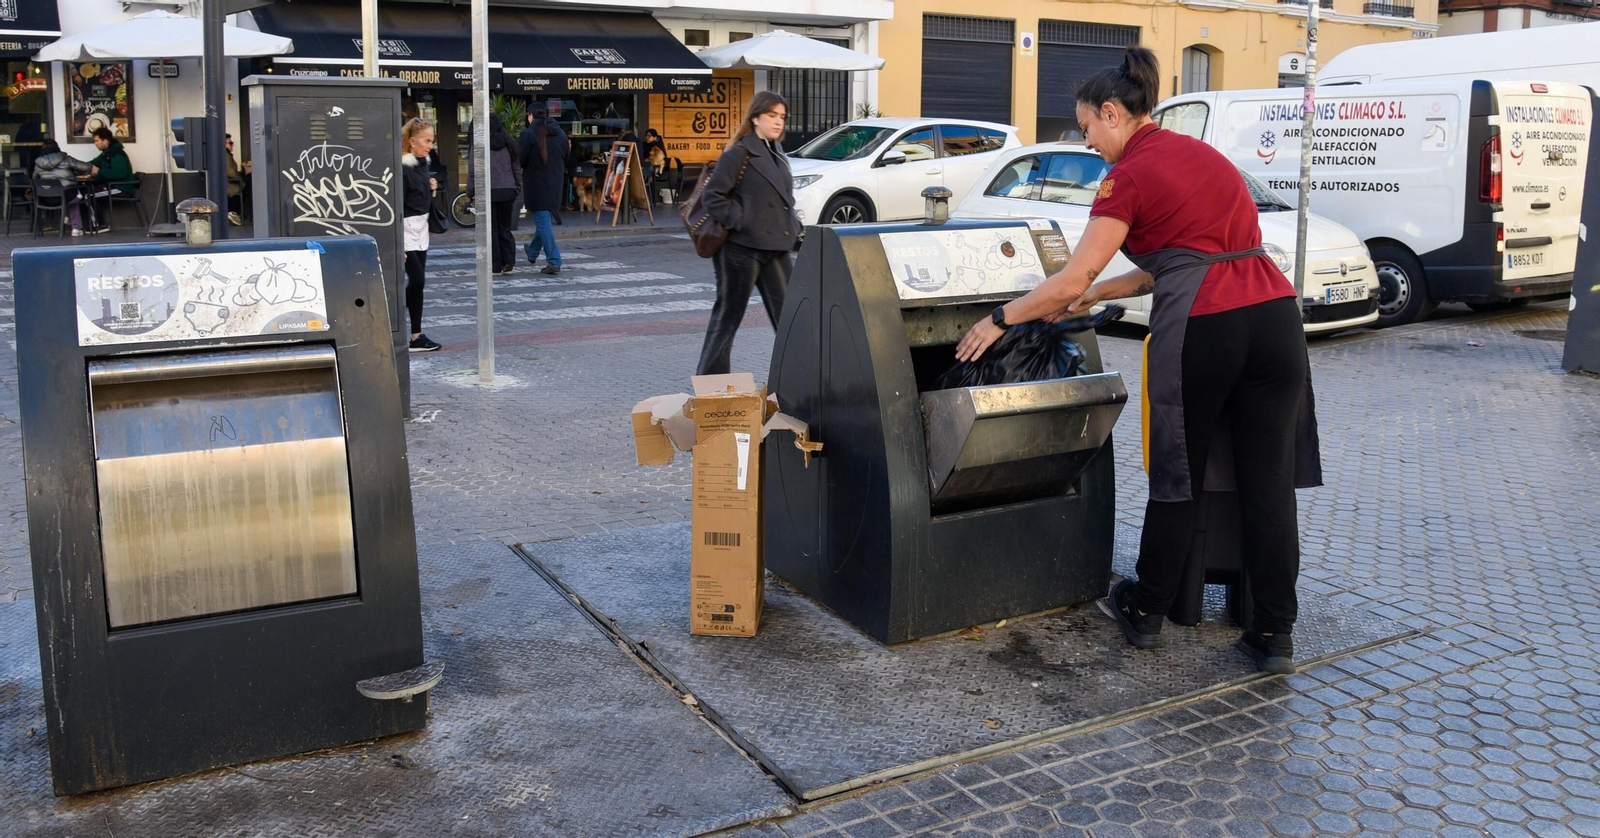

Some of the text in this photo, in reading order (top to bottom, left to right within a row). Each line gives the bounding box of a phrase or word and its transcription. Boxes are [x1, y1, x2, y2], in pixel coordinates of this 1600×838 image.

[0, 41, 22, 50] ETERÍA
[340, 68, 388, 78] CAFEÍA
[399, 70, 440, 84] OBRADOR
[567, 76, 610, 90] CAFETERÍA
[618, 78, 653, 90] OBRADOR
[1338, 102, 1386, 120] CLIMACO
[1388, 101, 1406, 119] S.L.
[1506, 106, 1554, 123] INSTALACIONES
[1555, 108, 1576, 124] CLIMACO
[692, 112, 726, 134] & GO
[1526, 131, 1586, 141] AIRE ACONDICIONADO
[1312, 139, 1377, 151] ALEFACCIÓN
[1312, 154, 1376, 165] ENTILACIÓN
[1268, 178, 1317, 190] TÉCNICS
[1320, 182, 1400, 192] AUTORIZADOS
[1512, 182, 1549, 193] www.climaco.es
[892, 246, 940, 258] RESTOS
[1513, 253, 1543, 266] 8852 KDT
[88, 274, 164, 290] RESTOS
[1331, 286, 1366, 301] 5580 HNF
[705, 410, 746, 418] cecotec
